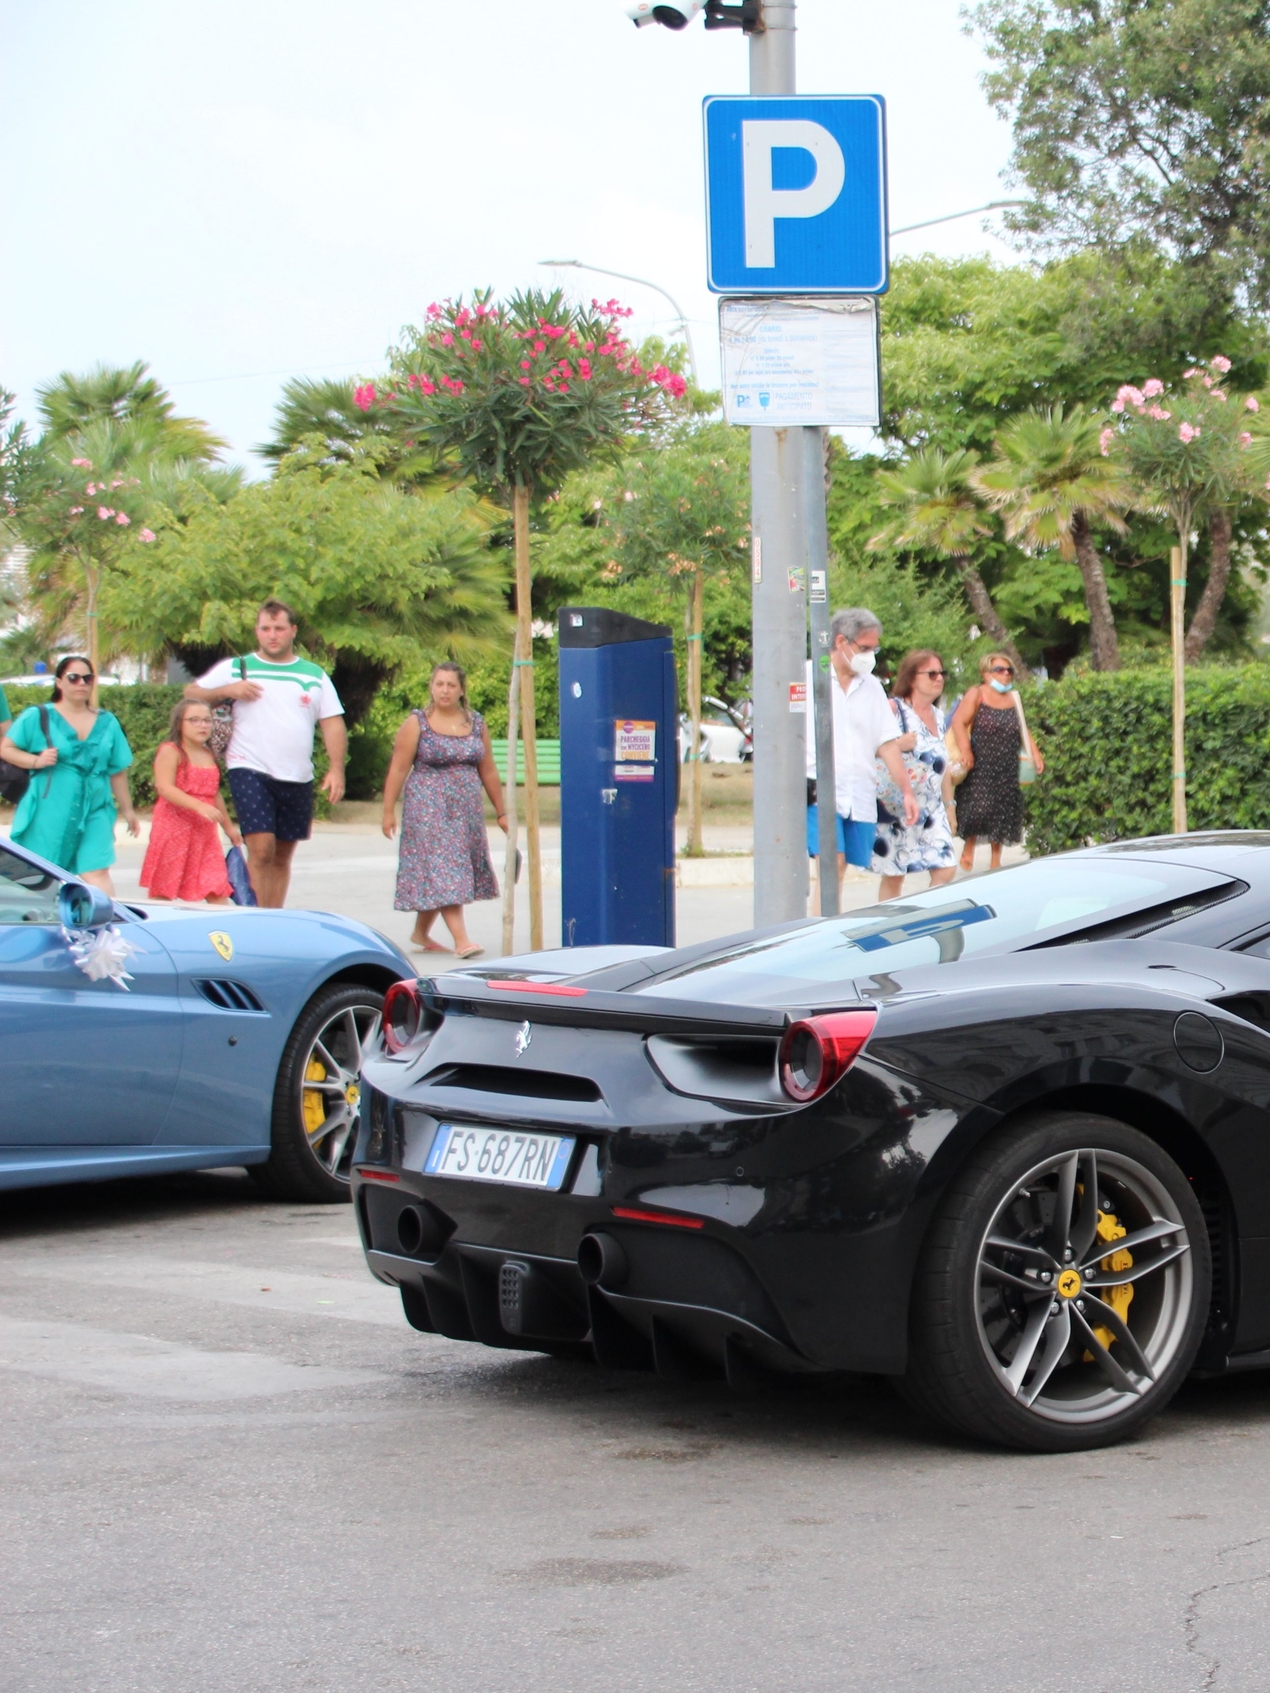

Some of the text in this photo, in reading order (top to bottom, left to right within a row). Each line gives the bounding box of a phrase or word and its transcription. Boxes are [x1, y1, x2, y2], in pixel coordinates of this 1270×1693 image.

[742, 119, 845, 269] P
[775, 391, 813, 401] PAGAMENTO
[776, 402, 812, 411] ANTICIPATO
[620, 735, 651, 743] PARCHEGGIA
